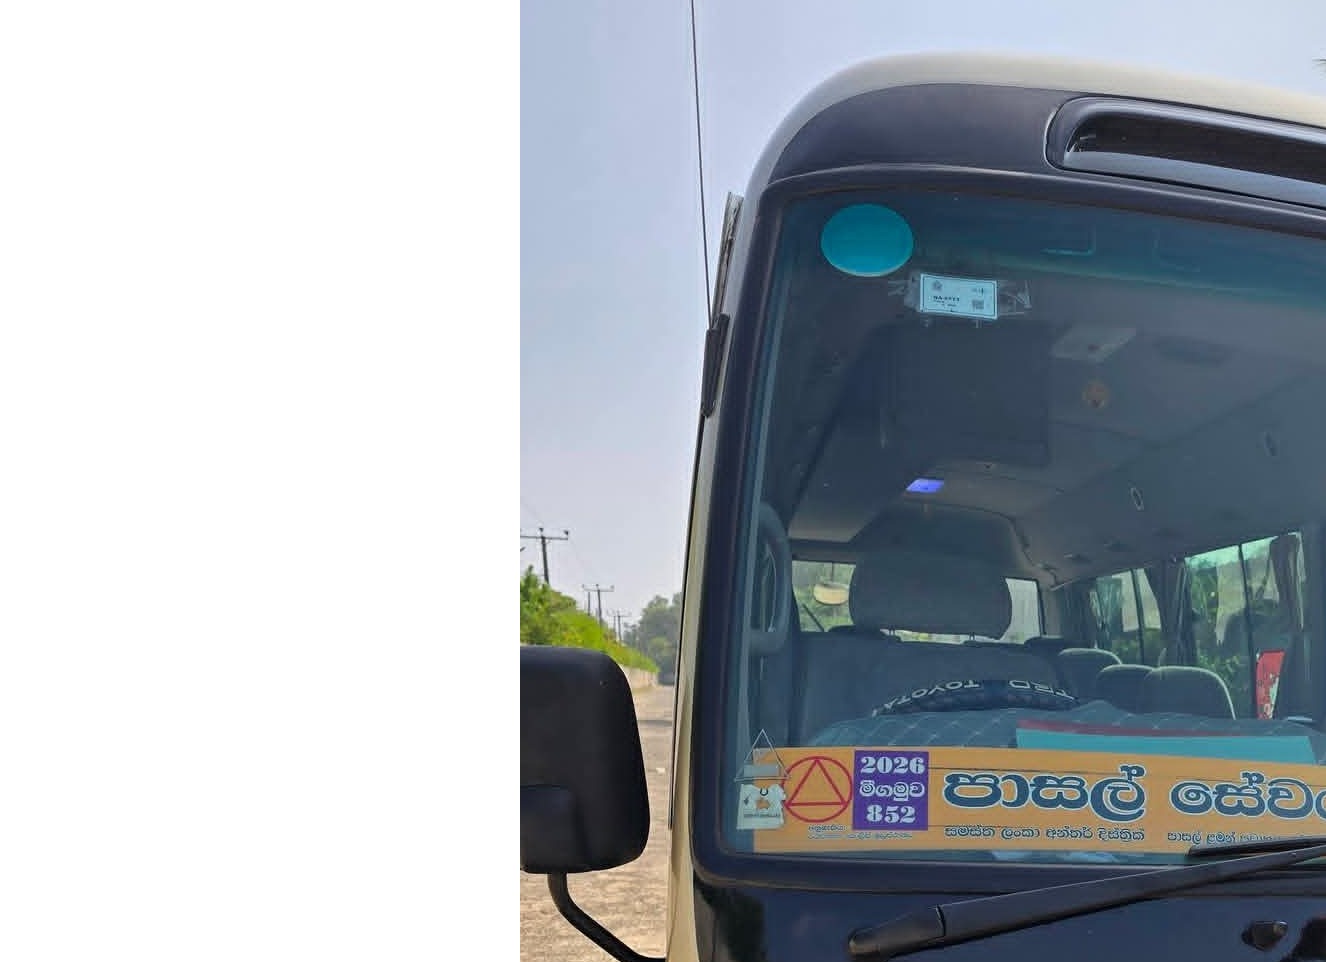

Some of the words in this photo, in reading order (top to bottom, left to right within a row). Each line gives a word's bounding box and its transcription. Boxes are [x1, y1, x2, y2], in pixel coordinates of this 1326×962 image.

[860, 756, 925, 774] 2026
[943, 765, 1146, 823] පාසල්
[866, 805, 916, 824] 852
